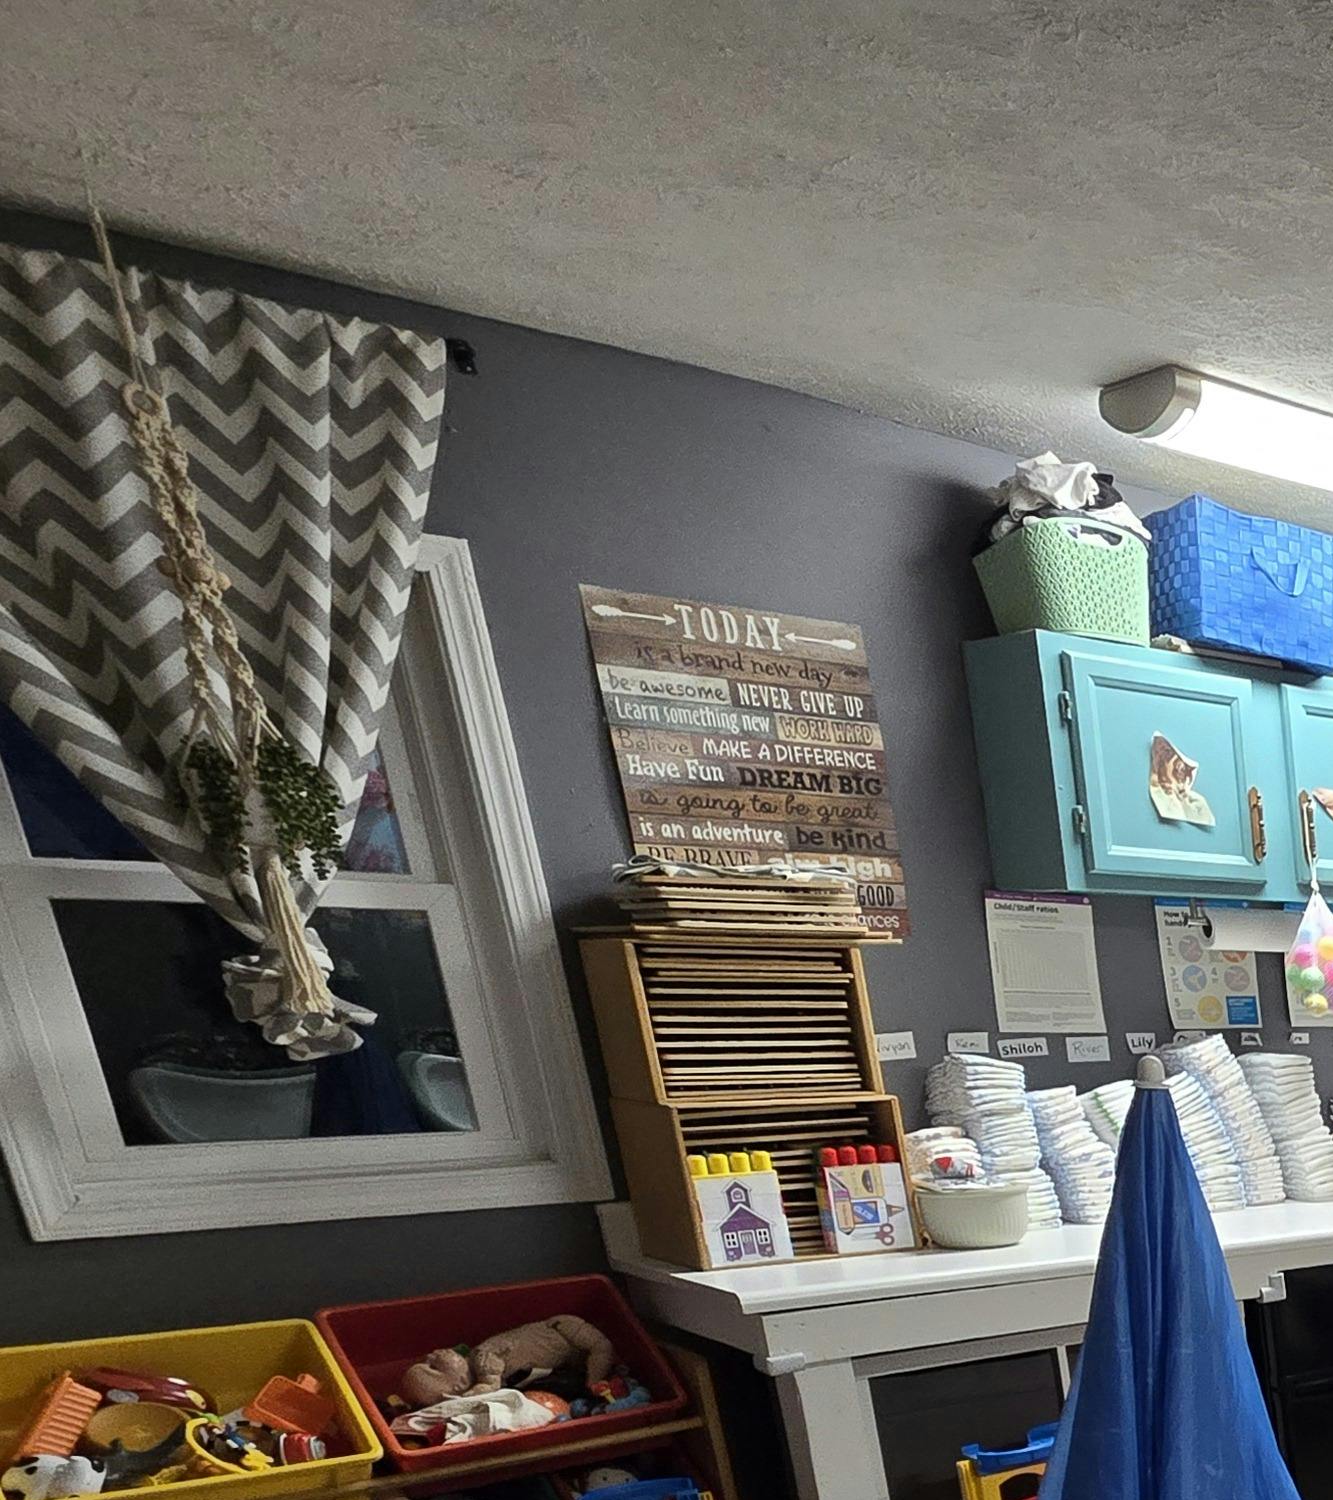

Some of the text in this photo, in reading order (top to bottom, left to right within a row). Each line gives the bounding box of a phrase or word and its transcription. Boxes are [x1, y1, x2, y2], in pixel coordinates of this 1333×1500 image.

[673, 604, 783, 651] TODAY
[677, 644, 745, 672] brand
[749, 659, 792, 677] new
[797, 661, 833, 689] day
[606, 668, 865, 718] be awesome NEVER GIVE UP
[615, 696, 874, 746] Learn something new WORK HARD
[616, 728, 877, 770] Believe MAKE A DIFFERENCE
[626, 754, 883, 796] Have Fun DREAM BIG
[676, 794, 746, 818] going
[749, 794, 778, 813] to
[784, 793, 810, 816] be
[817, 802, 879, 823] great
[639, 817, 887, 851] is an adventure be kind
[857, 884, 895, 907] GOOD
[857, 915, 901, 929] ances
[1211, 966, 1218, 976] 4
[1174, 998, 1181, 1008] 5
[1002, 1043, 1043, 1056] Shiloh
[1131, 1035, 1153, 1049] Lily
